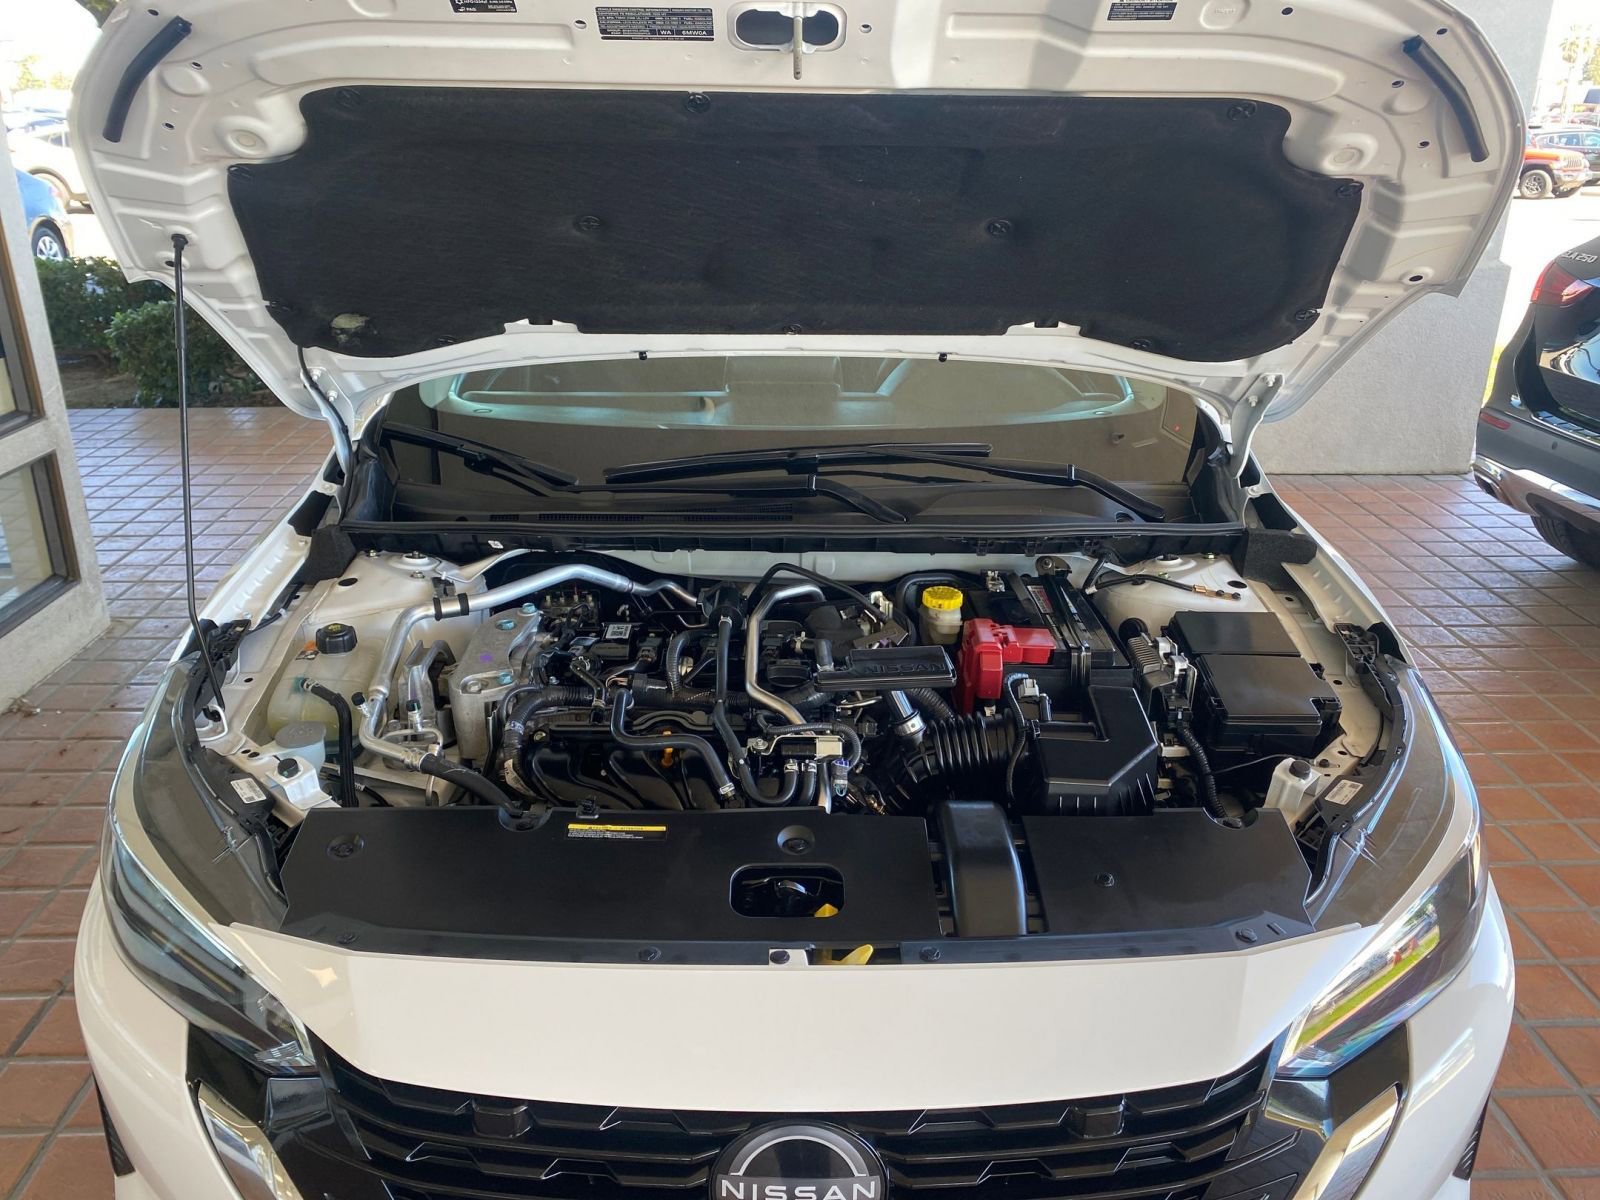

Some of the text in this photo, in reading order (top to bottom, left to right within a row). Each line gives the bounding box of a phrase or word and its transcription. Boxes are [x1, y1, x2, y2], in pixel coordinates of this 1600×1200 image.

[1576, 253, 1598, 263] 250
[864, 663, 946, 674] NISSAN
[721, 1179, 875, 1200] NISSAN
